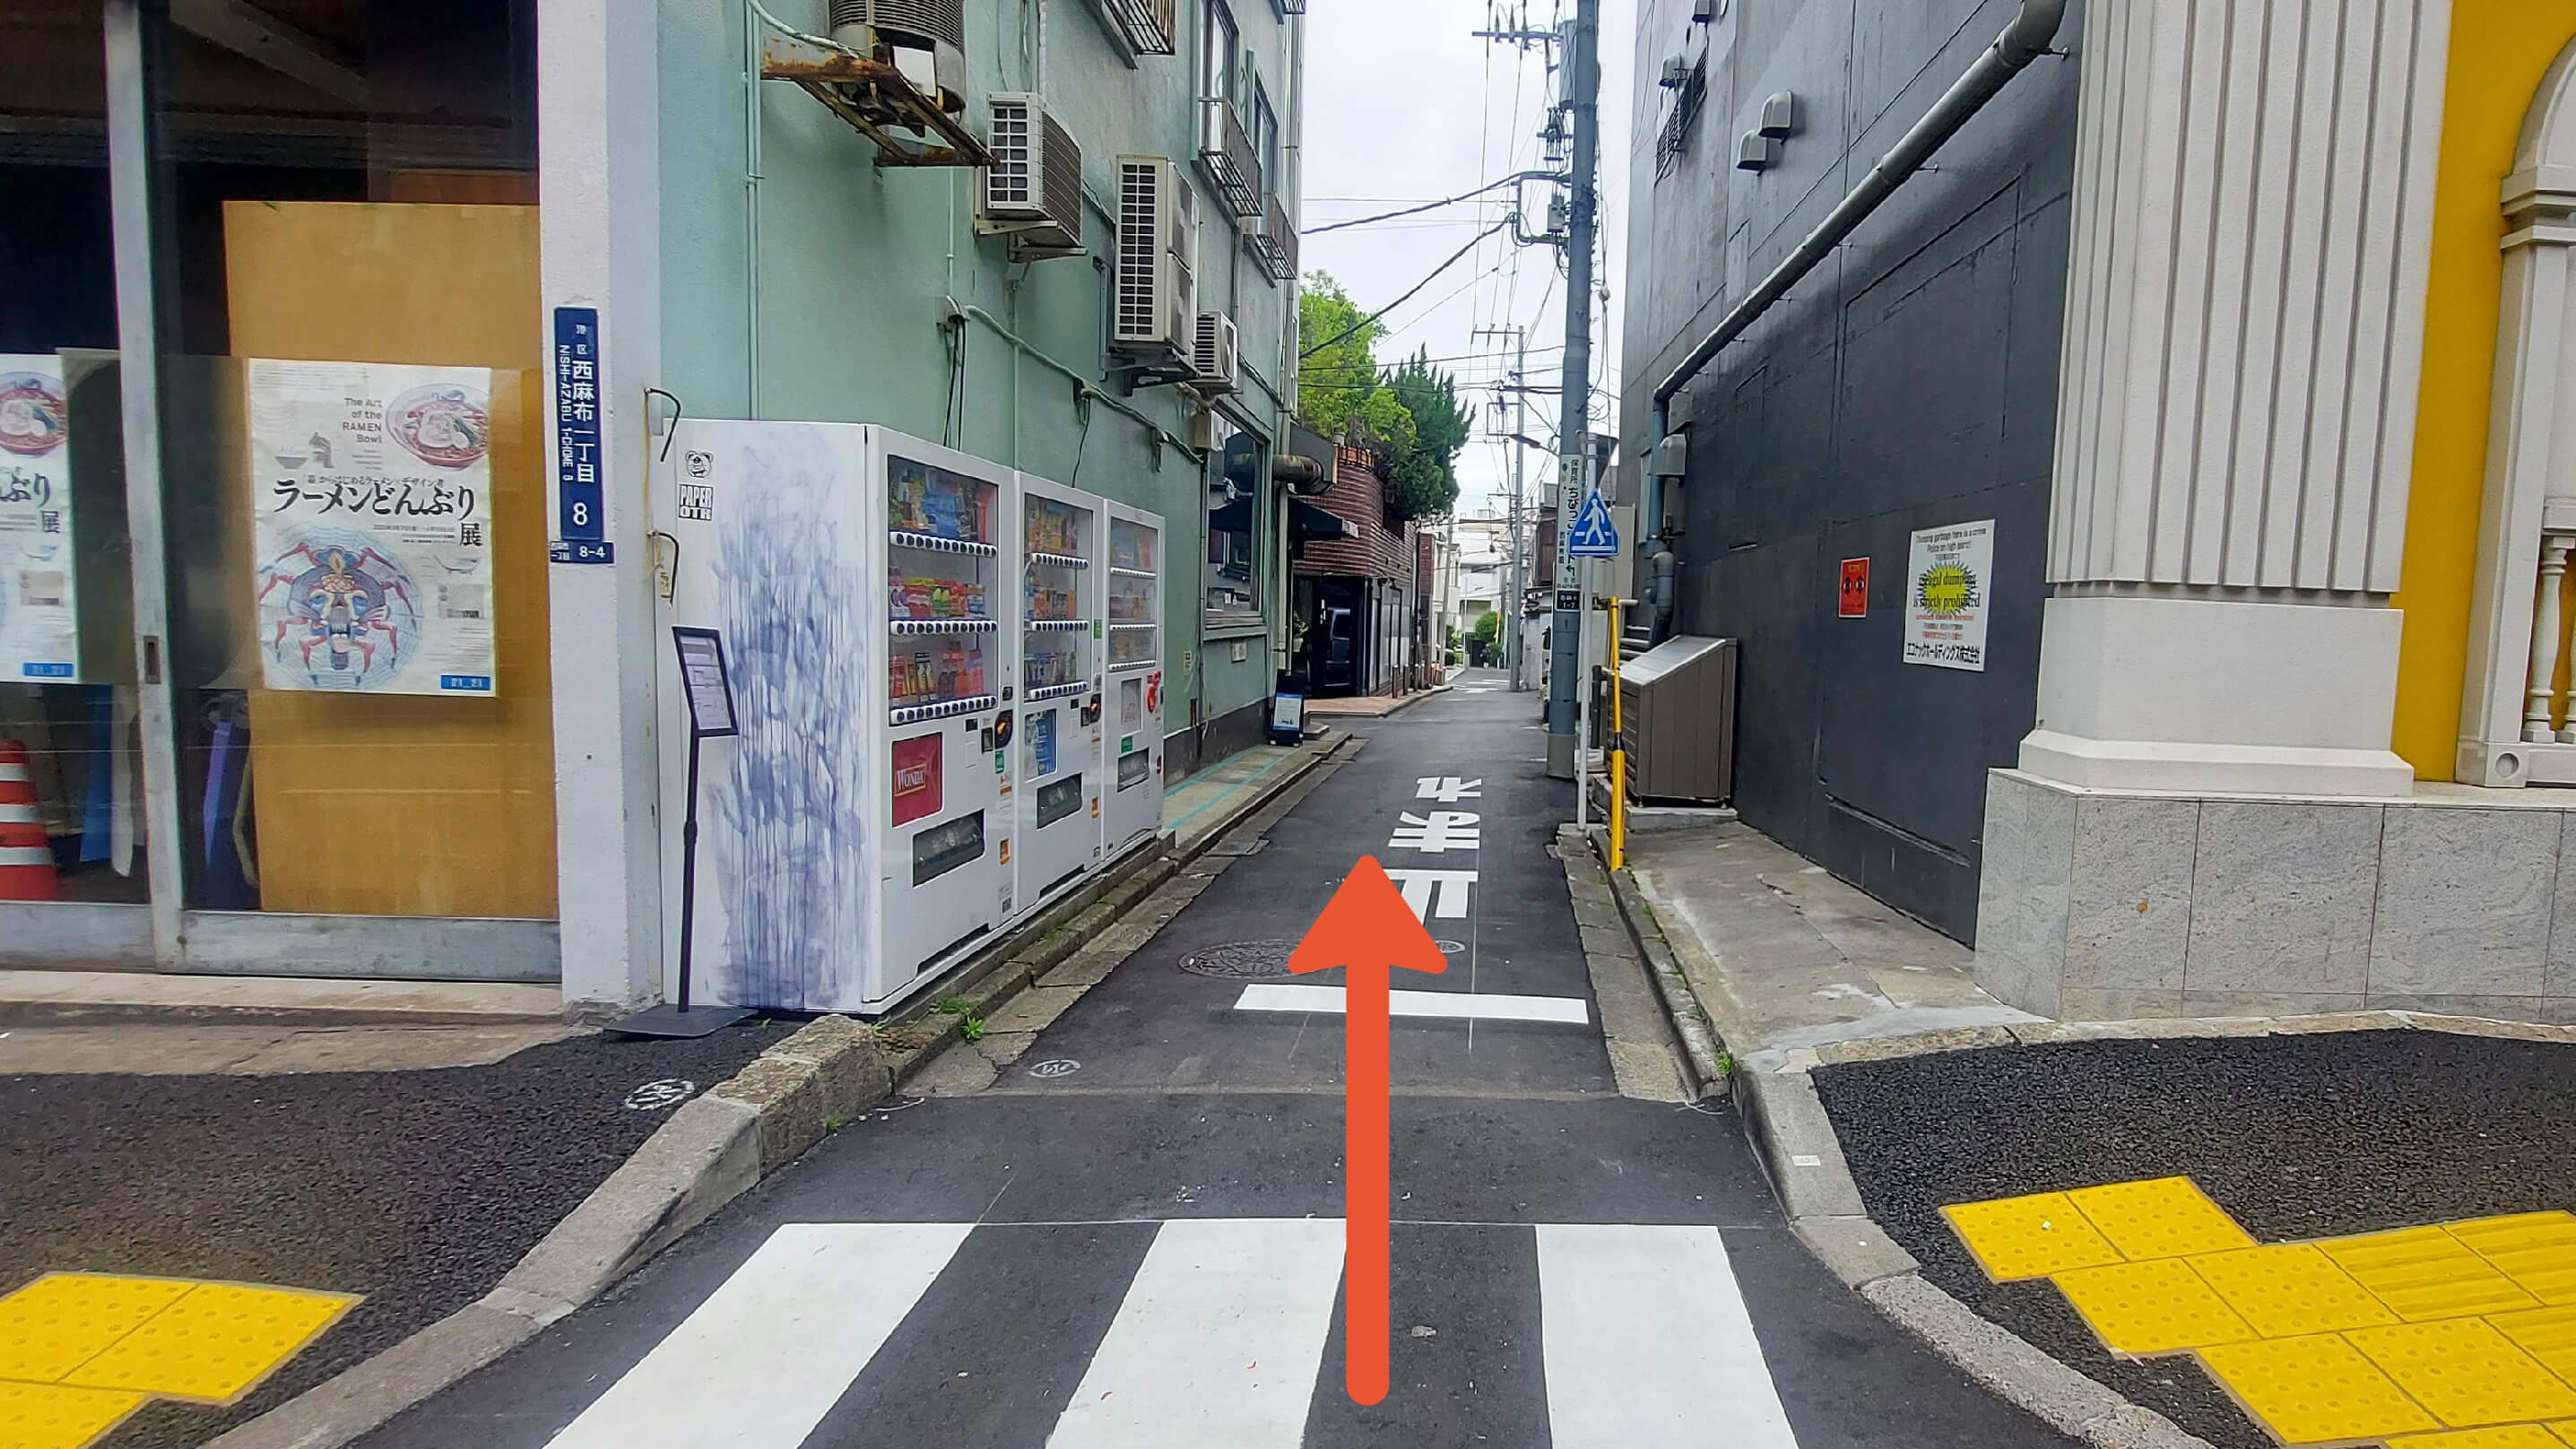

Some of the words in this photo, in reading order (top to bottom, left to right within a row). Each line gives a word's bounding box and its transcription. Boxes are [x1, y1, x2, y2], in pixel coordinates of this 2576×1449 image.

[559, 344, 574, 422] NISHI-AZABU
[344, 397, 363, 406] The
[366, 399, 382, 407] Art
[343, 421, 382, 432] RAMEN
[351, 410, 361, 418] of
[364, 410, 382, 420] the
[572, 360, 595, 483] 西麻布一丁目
[357, 434, 382, 444] Bowl
[560, 427, 574, 468] 1-CHOME
[0, 473, 50, 508] ぶり
[273, 479, 475, 521] ラーメンどんぶり
[681, 485, 713, 508] PAPER
[40, 510, 60, 534] 展
[573, 502, 588, 526] 8
[459, 522, 483, 547] 展
[578, 545, 606, 559] 8-4
